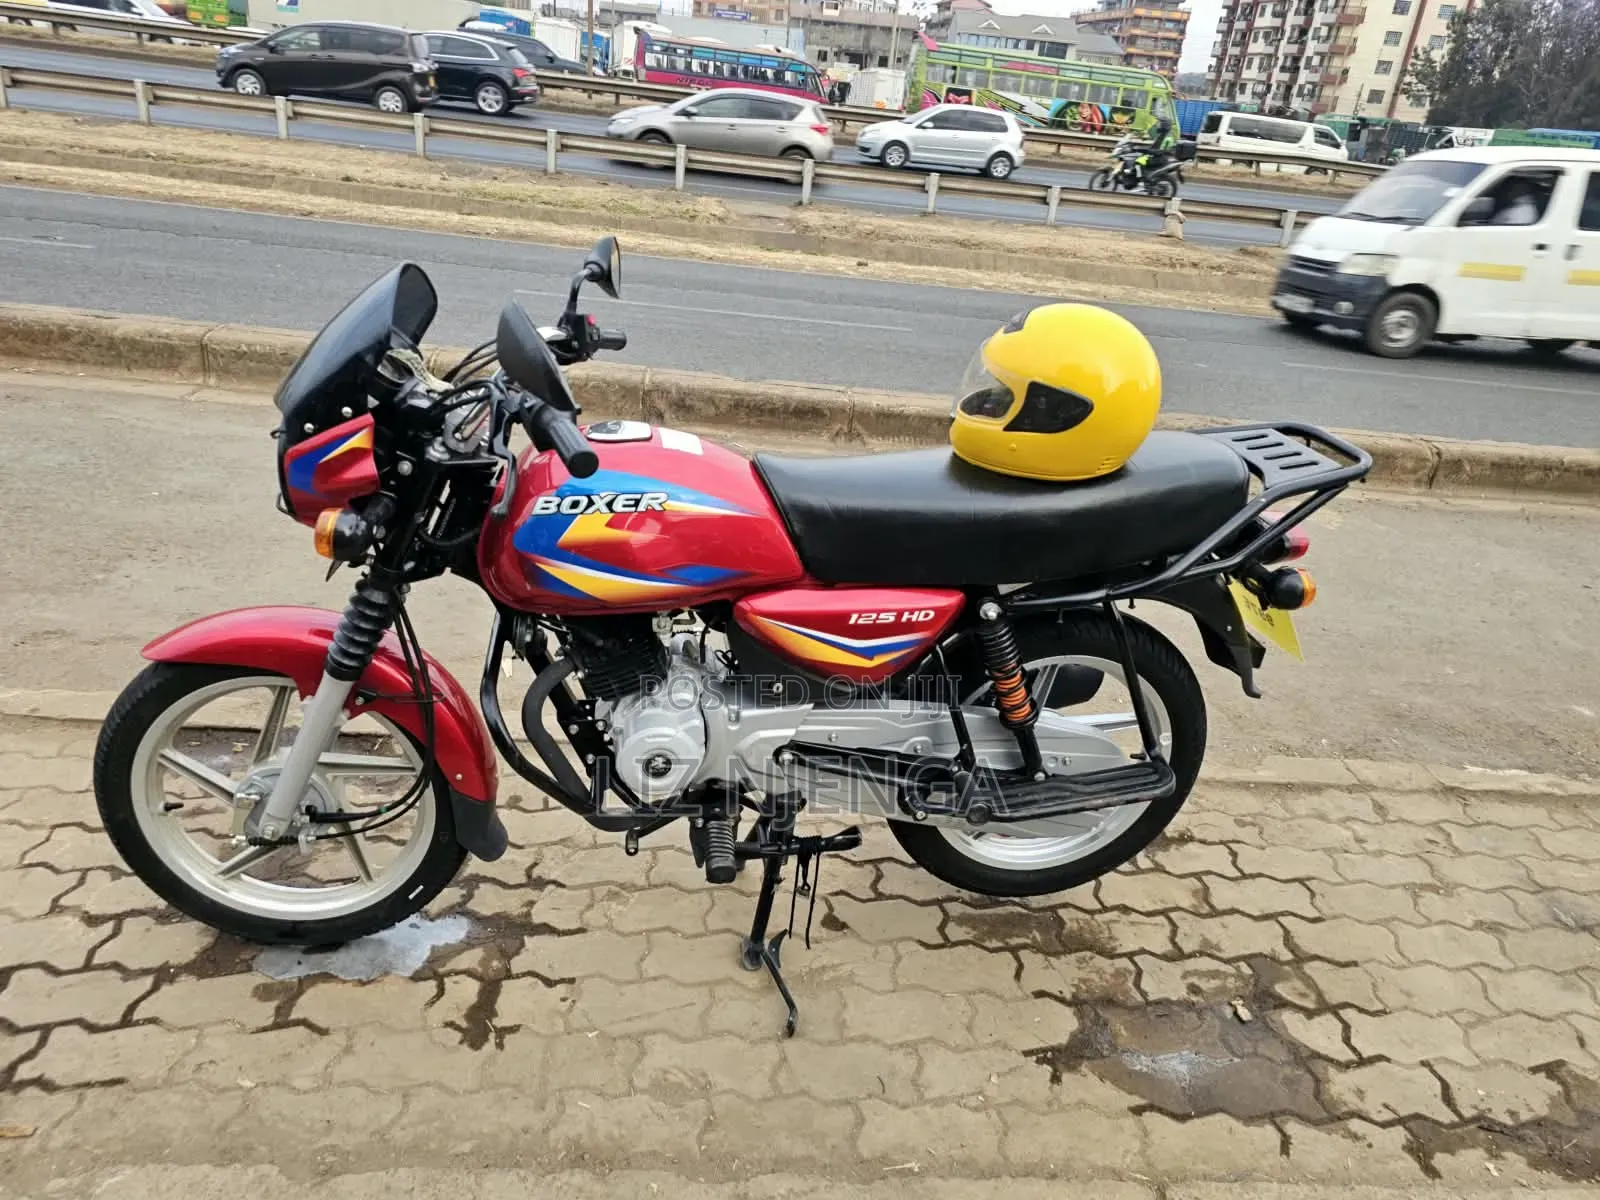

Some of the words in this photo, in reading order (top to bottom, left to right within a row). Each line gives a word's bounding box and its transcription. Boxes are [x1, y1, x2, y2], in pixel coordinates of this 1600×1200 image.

[532, 492, 669, 516] BOXER
[848, 611, 897, 625] 125
[901, 609, 935, 622] HD
